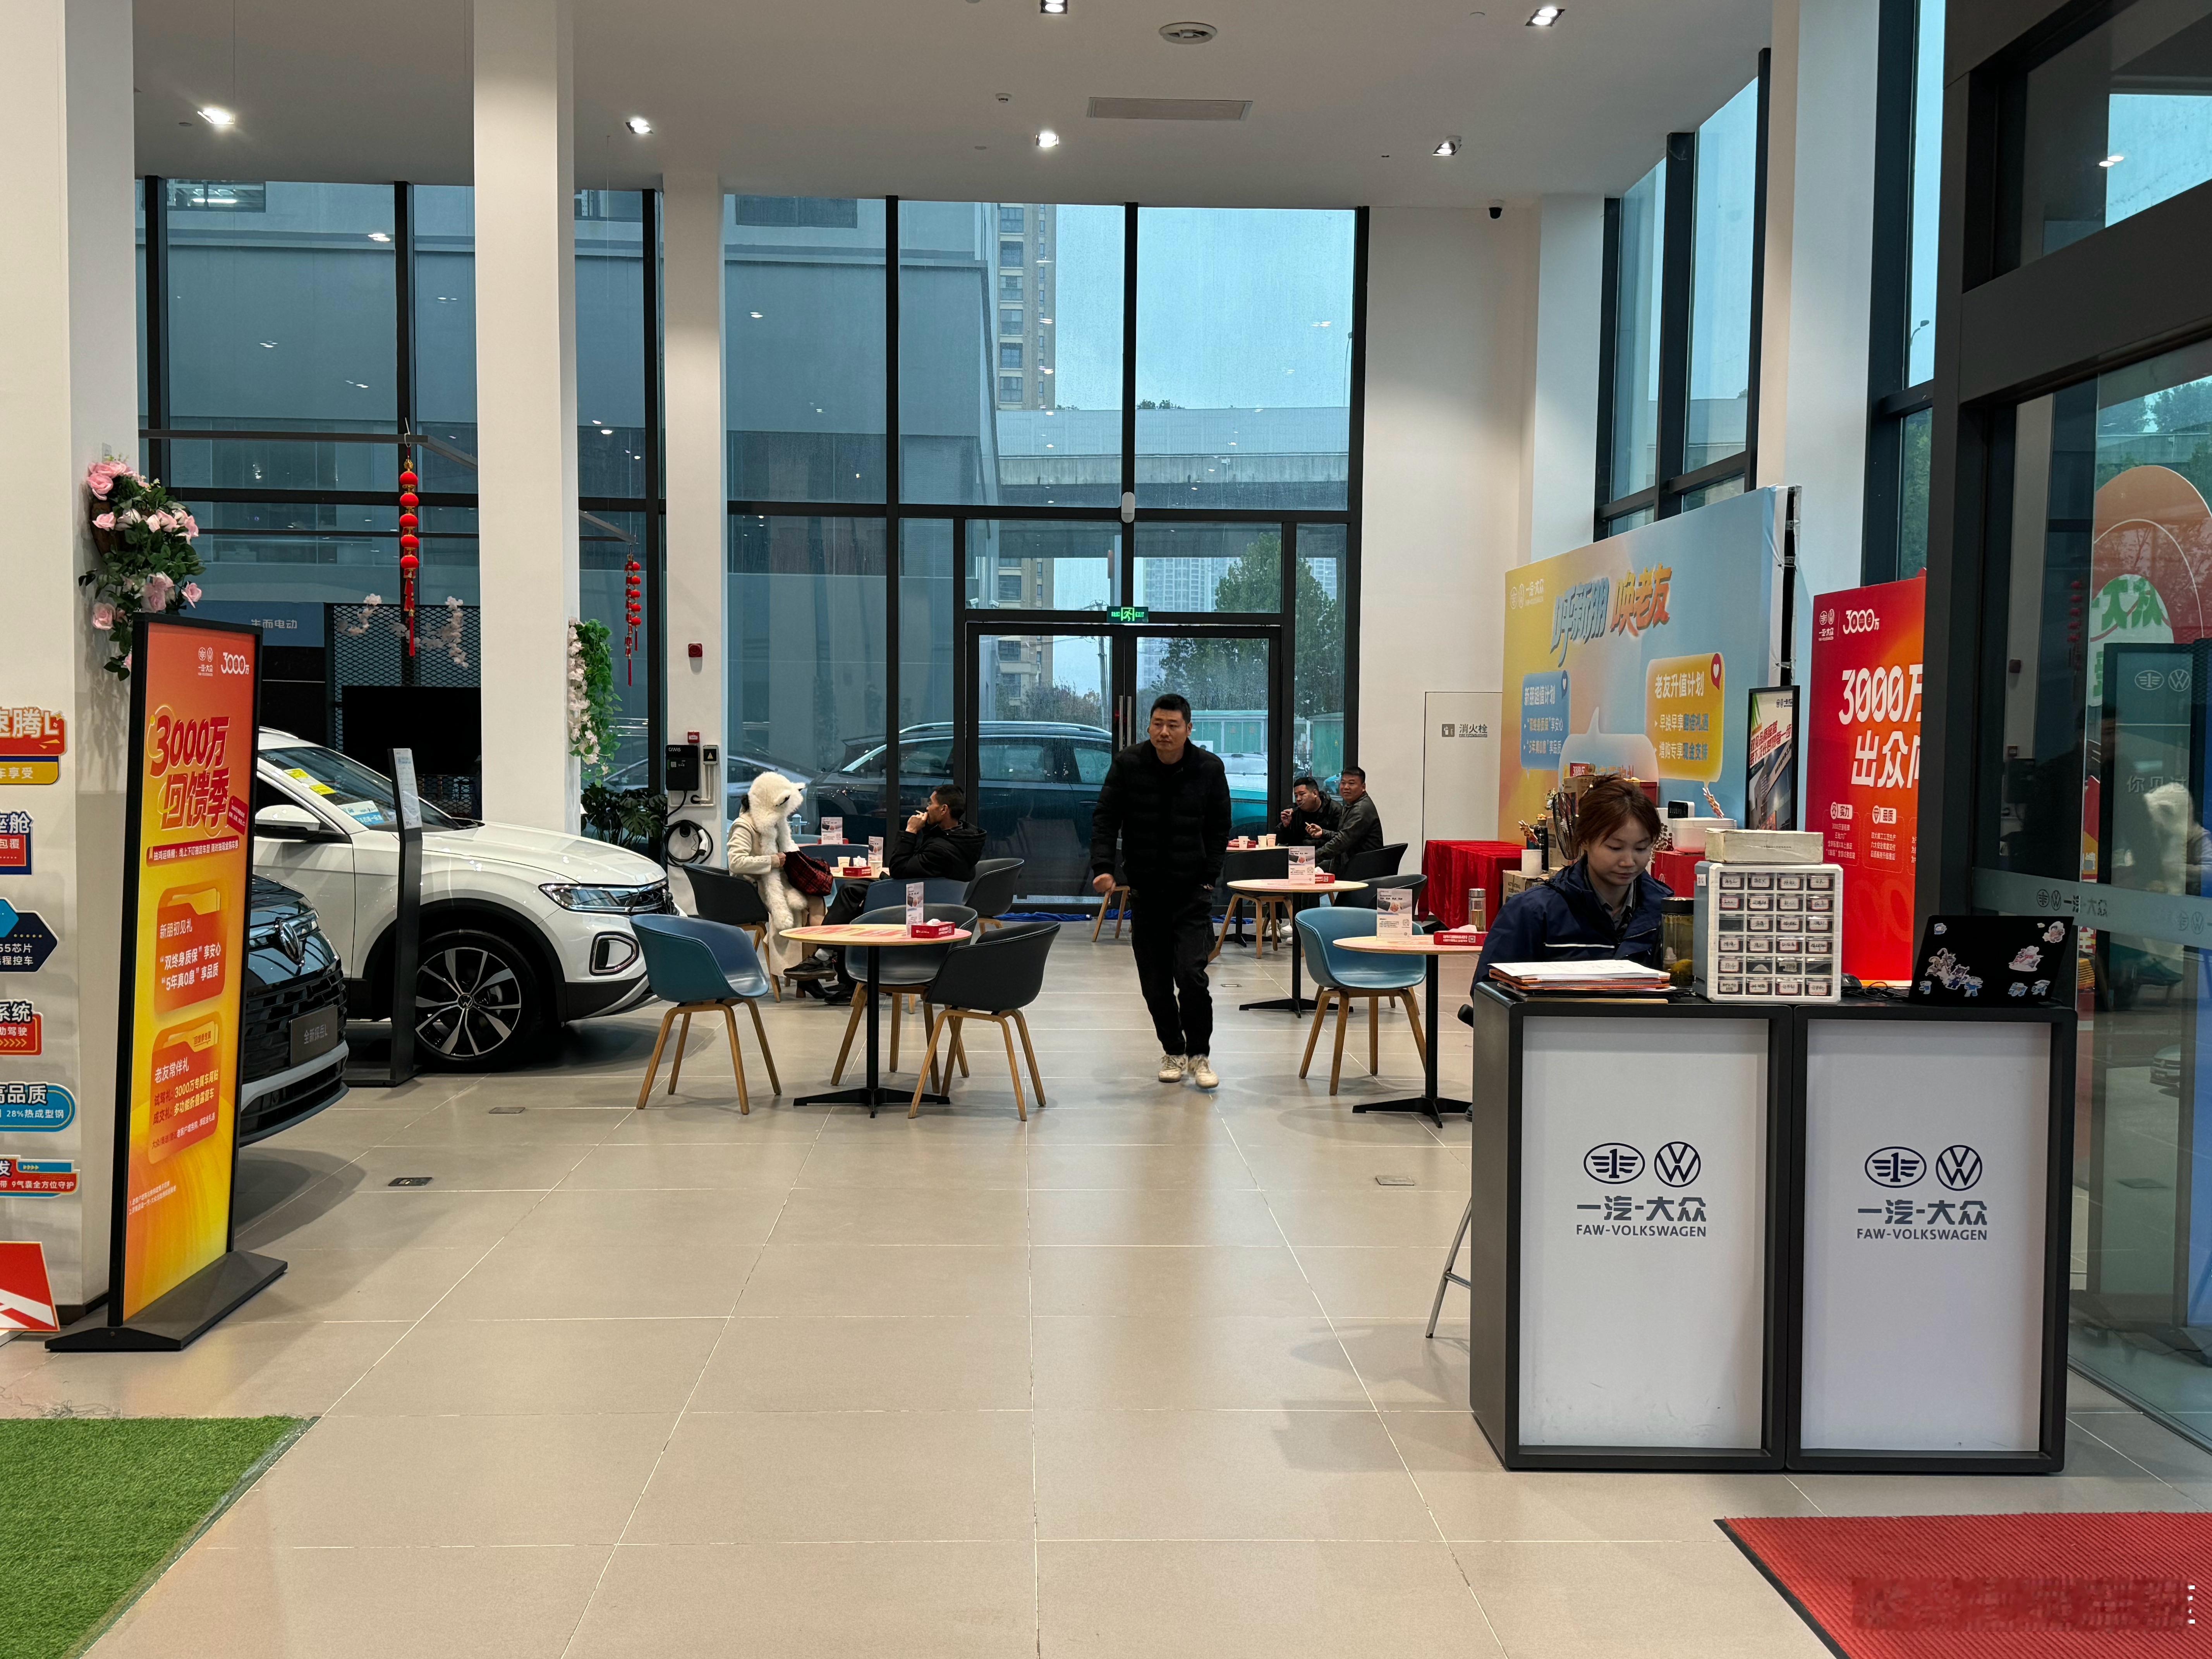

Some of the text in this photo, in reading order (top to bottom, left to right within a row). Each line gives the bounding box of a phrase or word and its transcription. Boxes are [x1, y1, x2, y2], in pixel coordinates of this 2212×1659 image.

[1610, 563, 1672, 637] 唤老友
[251, 619, 297, 629] 生而电动
[1843, 609, 1880, 634] 3000万
[221, 652, 249, 675] 3000万
[1655, 671, 1704, 698] 老友升值计划
[1838, 664, 1923, 725] 3000万
[1459, 723, 1487, 733] 消火栓
[150, 715, 230, 778] 3000万
[161, 767, 230, 831] 回馈季
[1840, 805, 1850, 818] 实力
[1883, 809, 1893, 822] 品质
[160, 918, 193, 939] 新朋初见礼
[0, 956, 33, 966] 程控车
[155, 1057, 189, 1084] 老友常伴礼
[0, 1085, 47, 1104] 品质
[7, 1109, 64, 1119] 28%热成型钢
[12, 1180, 74, 1189] 9气囊全方位守护
[1577, 1196, 1707, 1222] 一汽-大众
[1858, 1199, 1988, 1226] 一汽-大众
[1576, 1224, 1706, 1237] FAW-VOLKSWAGEN
[1857, 1228, 1987, 1240] FAW-VOLKSWAGEN
